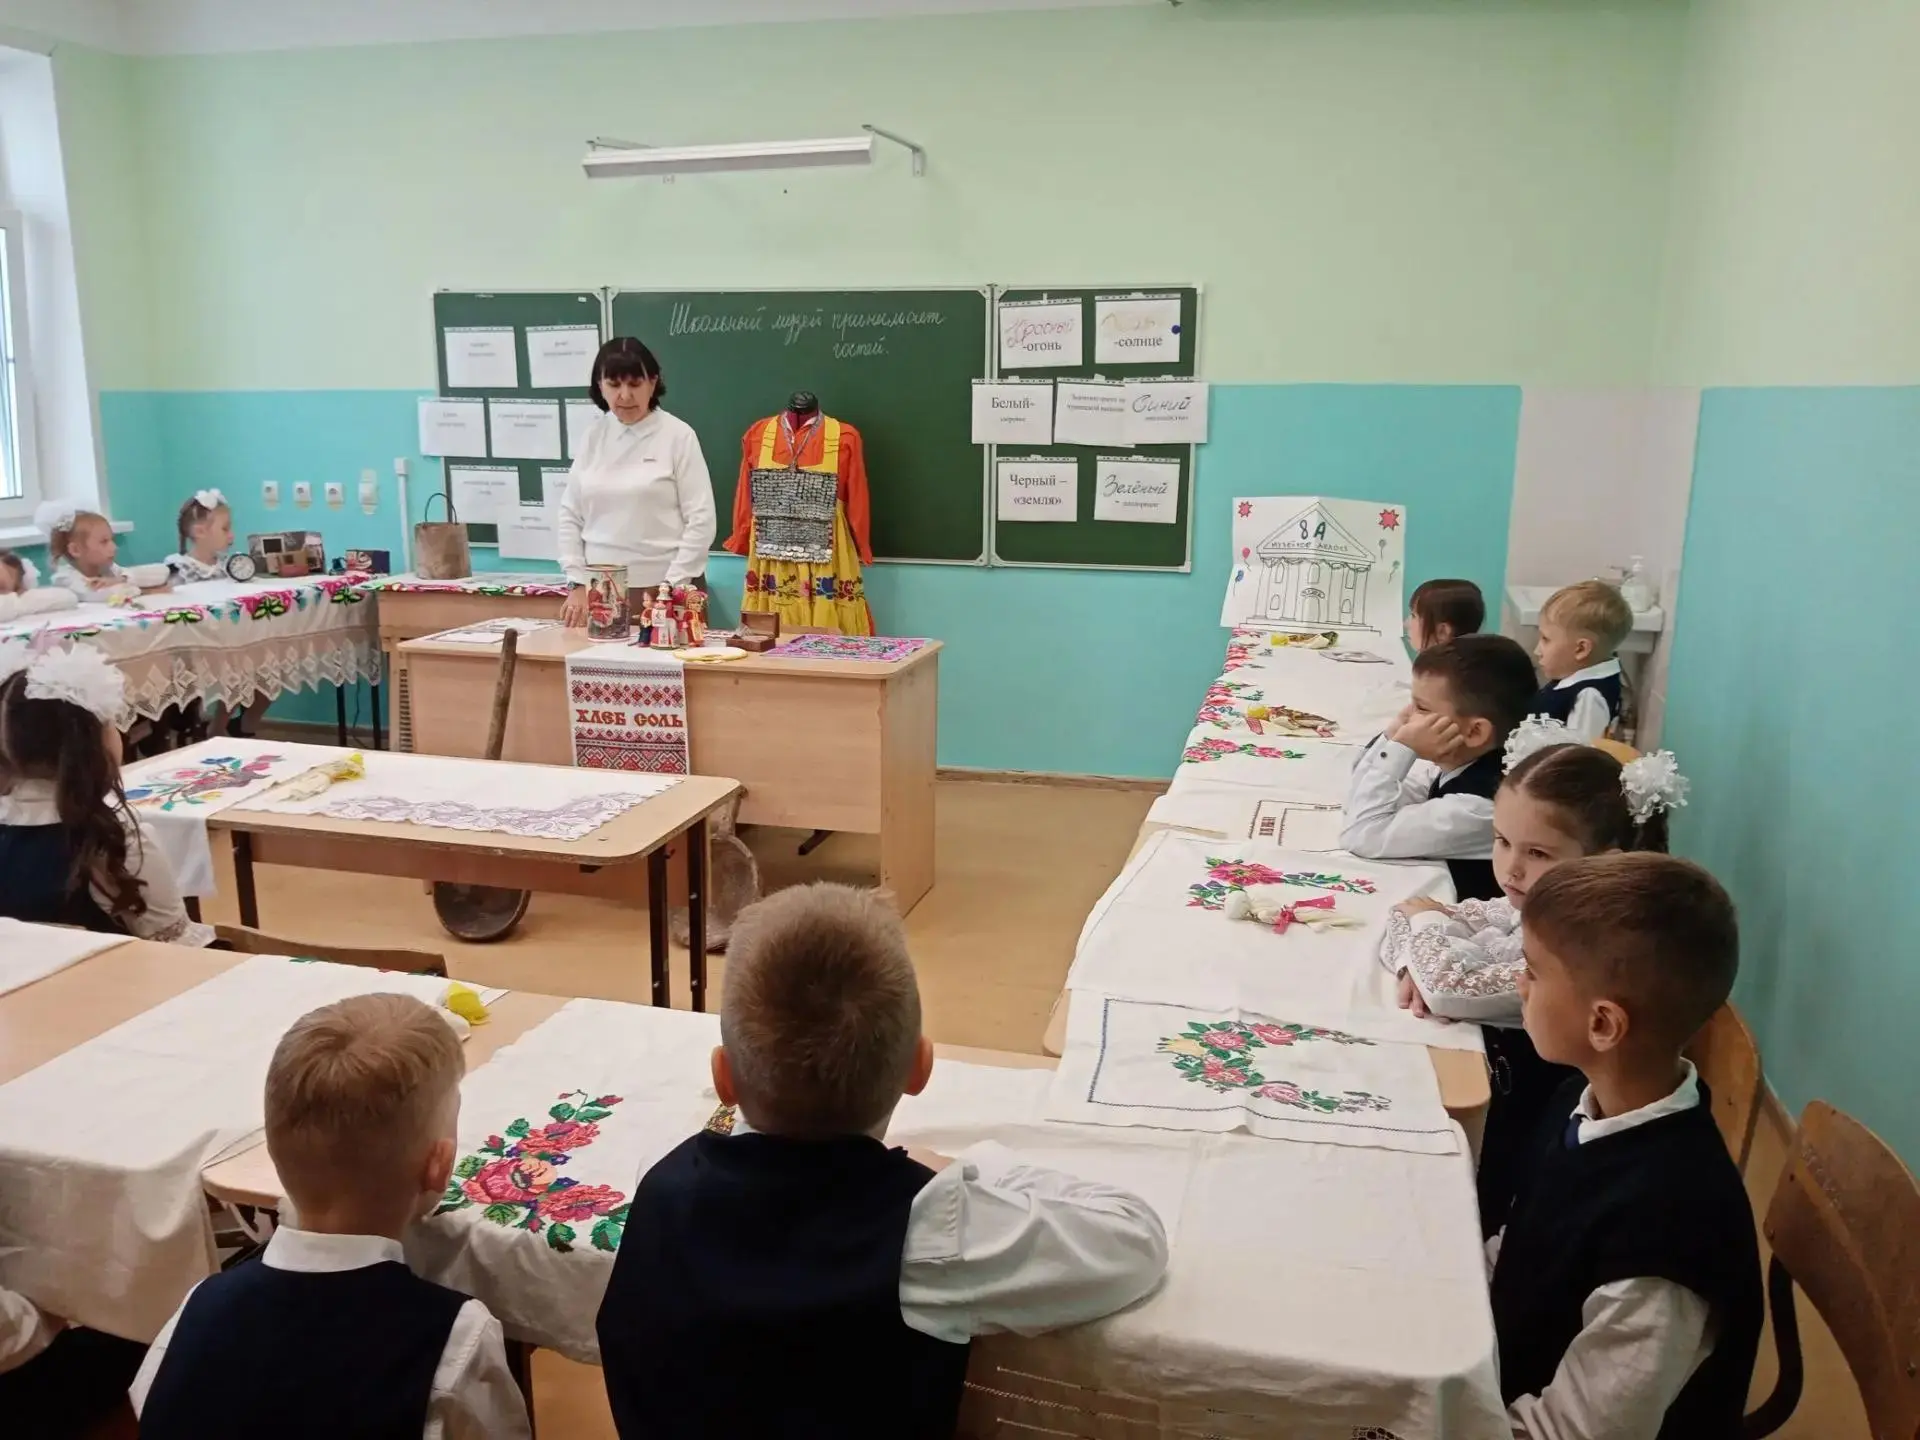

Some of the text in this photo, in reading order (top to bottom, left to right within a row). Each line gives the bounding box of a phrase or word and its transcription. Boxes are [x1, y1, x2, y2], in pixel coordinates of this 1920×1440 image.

[669, 302, 945, 346] Школьный музей принимает
[1132, 394, 1194, 414] Синий
[575, 709, 684, 728] ХЛЕБ СОЛЬ
